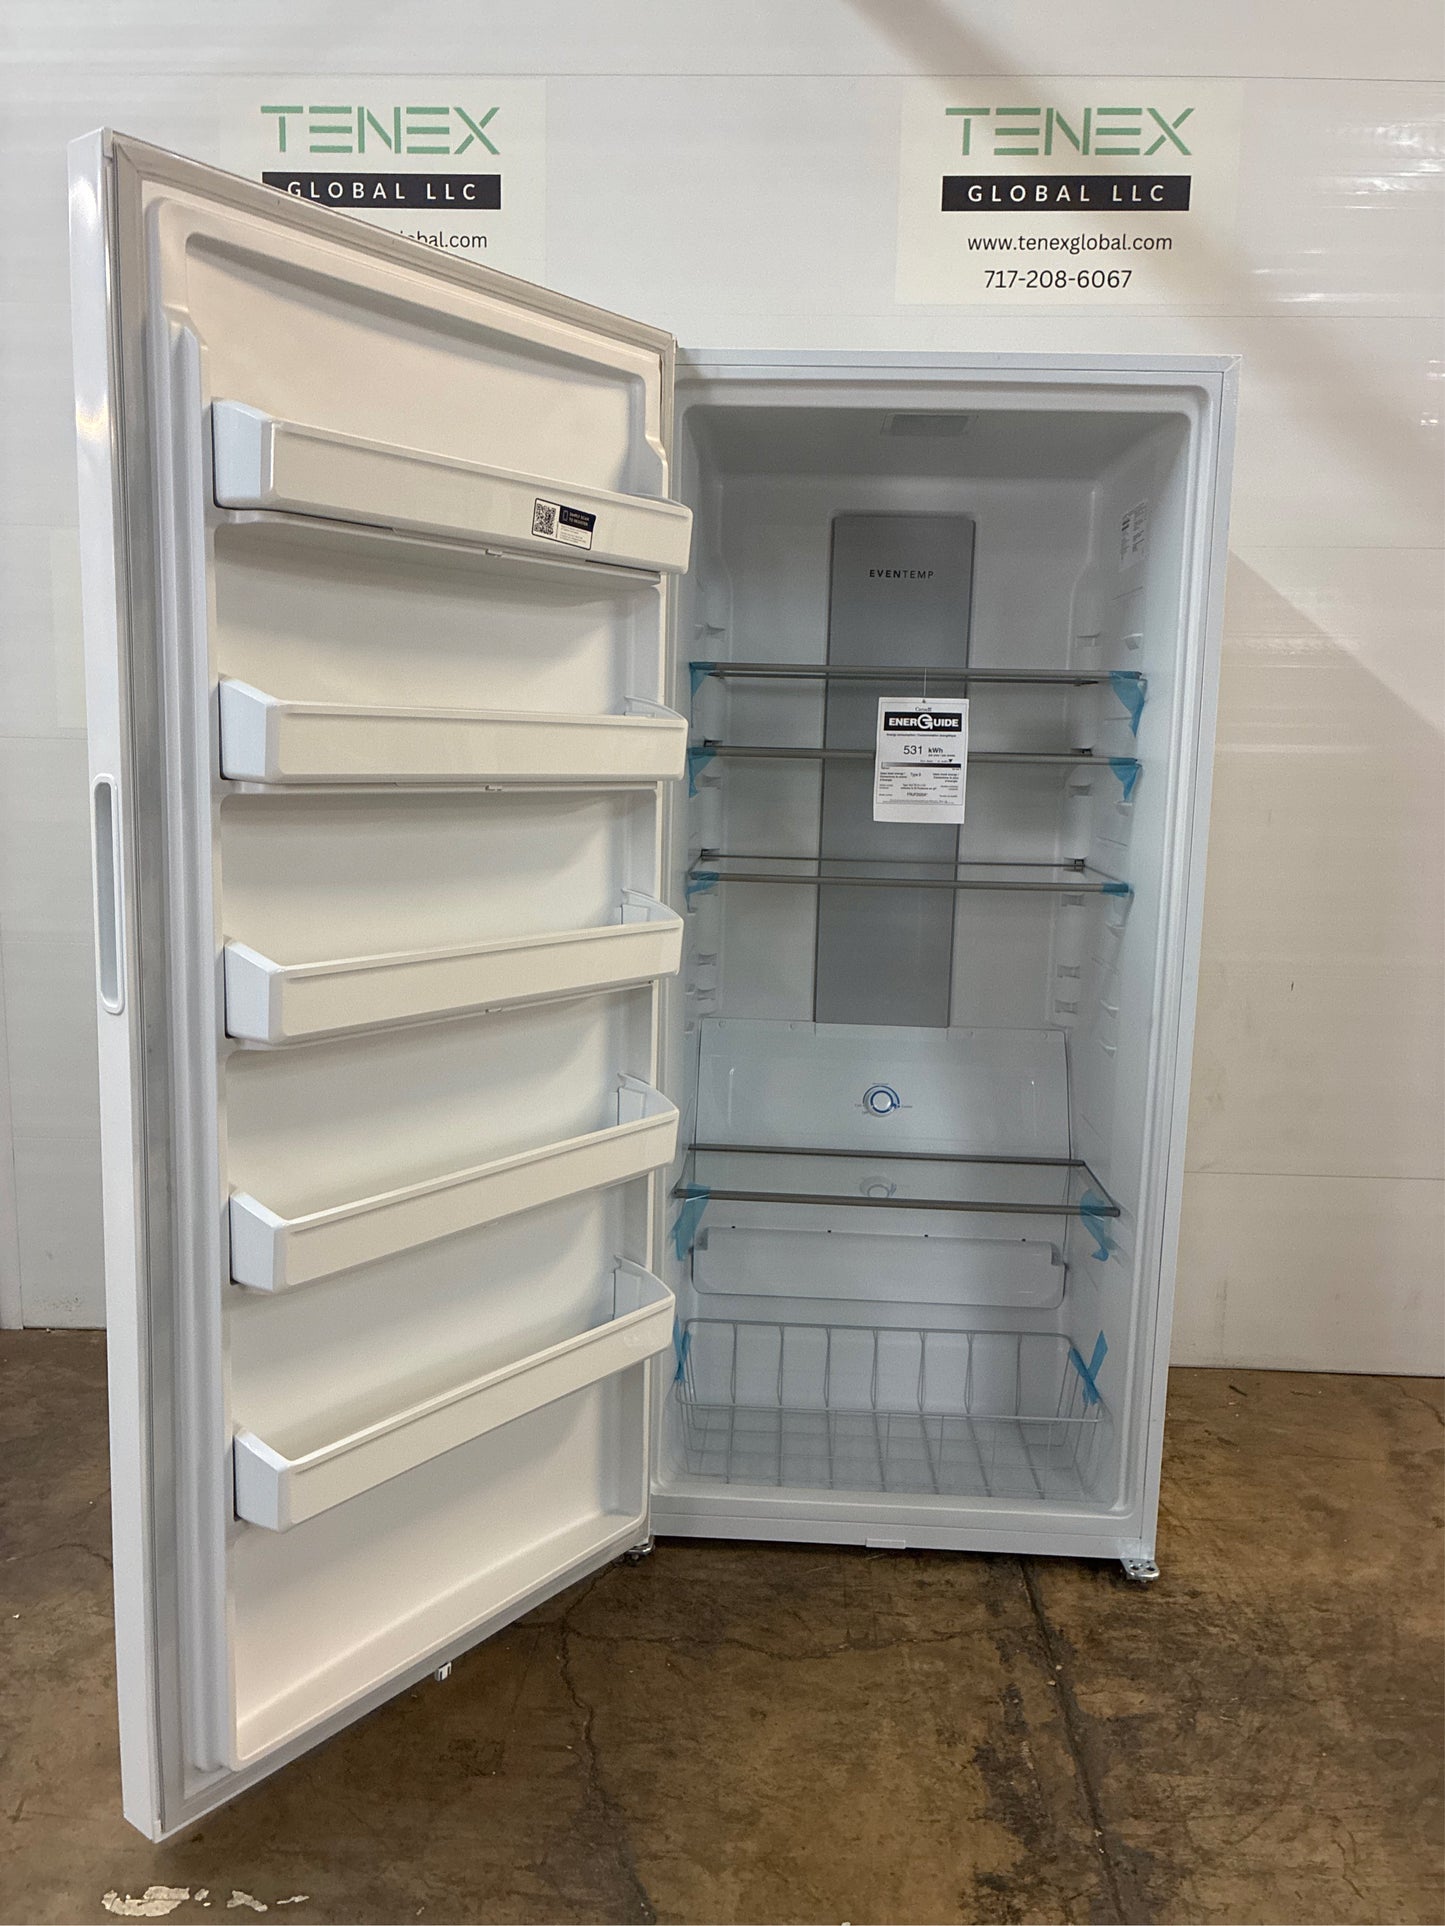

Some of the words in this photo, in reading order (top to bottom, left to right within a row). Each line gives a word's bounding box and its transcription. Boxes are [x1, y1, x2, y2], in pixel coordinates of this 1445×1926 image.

[260, 105, 501, 155] TENEX
[945, 107, 1195, 156] TENEX
[287, 181, 405, 200] GLOBAL
[426, 183, 477, 200] LLC
[967, 185, 1090, 202] GLOBAL
[1112, 185, 1164, 202] LLC
[967, 233, 1173, 255] www.tenexglobal.com
[984, 270, 1132, 289] 717-208-6067
[869, 569, 934, 579] EVENTEMP
[889, 714, 959, 729] ENERGUIDE
[903, 745, 922, 755] 531
